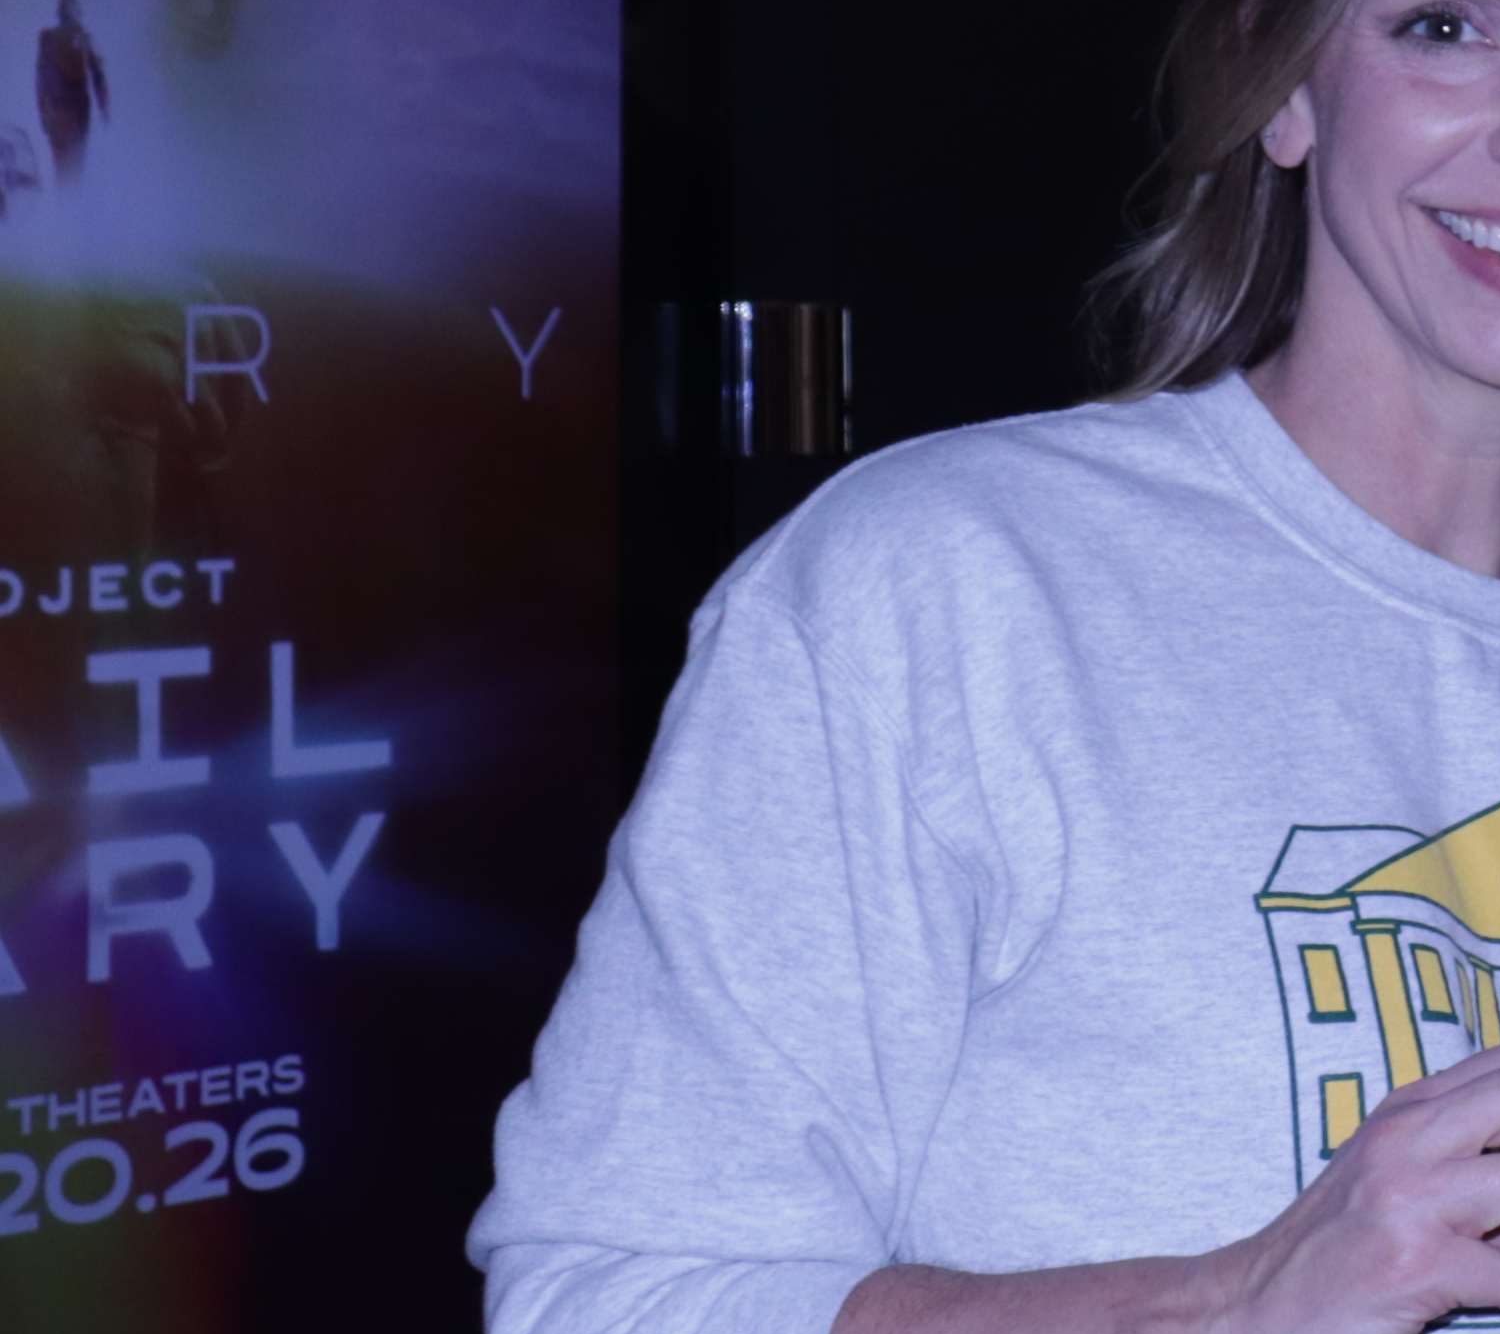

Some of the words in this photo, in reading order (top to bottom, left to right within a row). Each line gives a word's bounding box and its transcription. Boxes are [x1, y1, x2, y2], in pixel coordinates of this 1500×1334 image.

[0, 640, 392, 807] IL
[0, 811, 387, 995] RY
[6, 1054, 306, 1136] THEATERS
